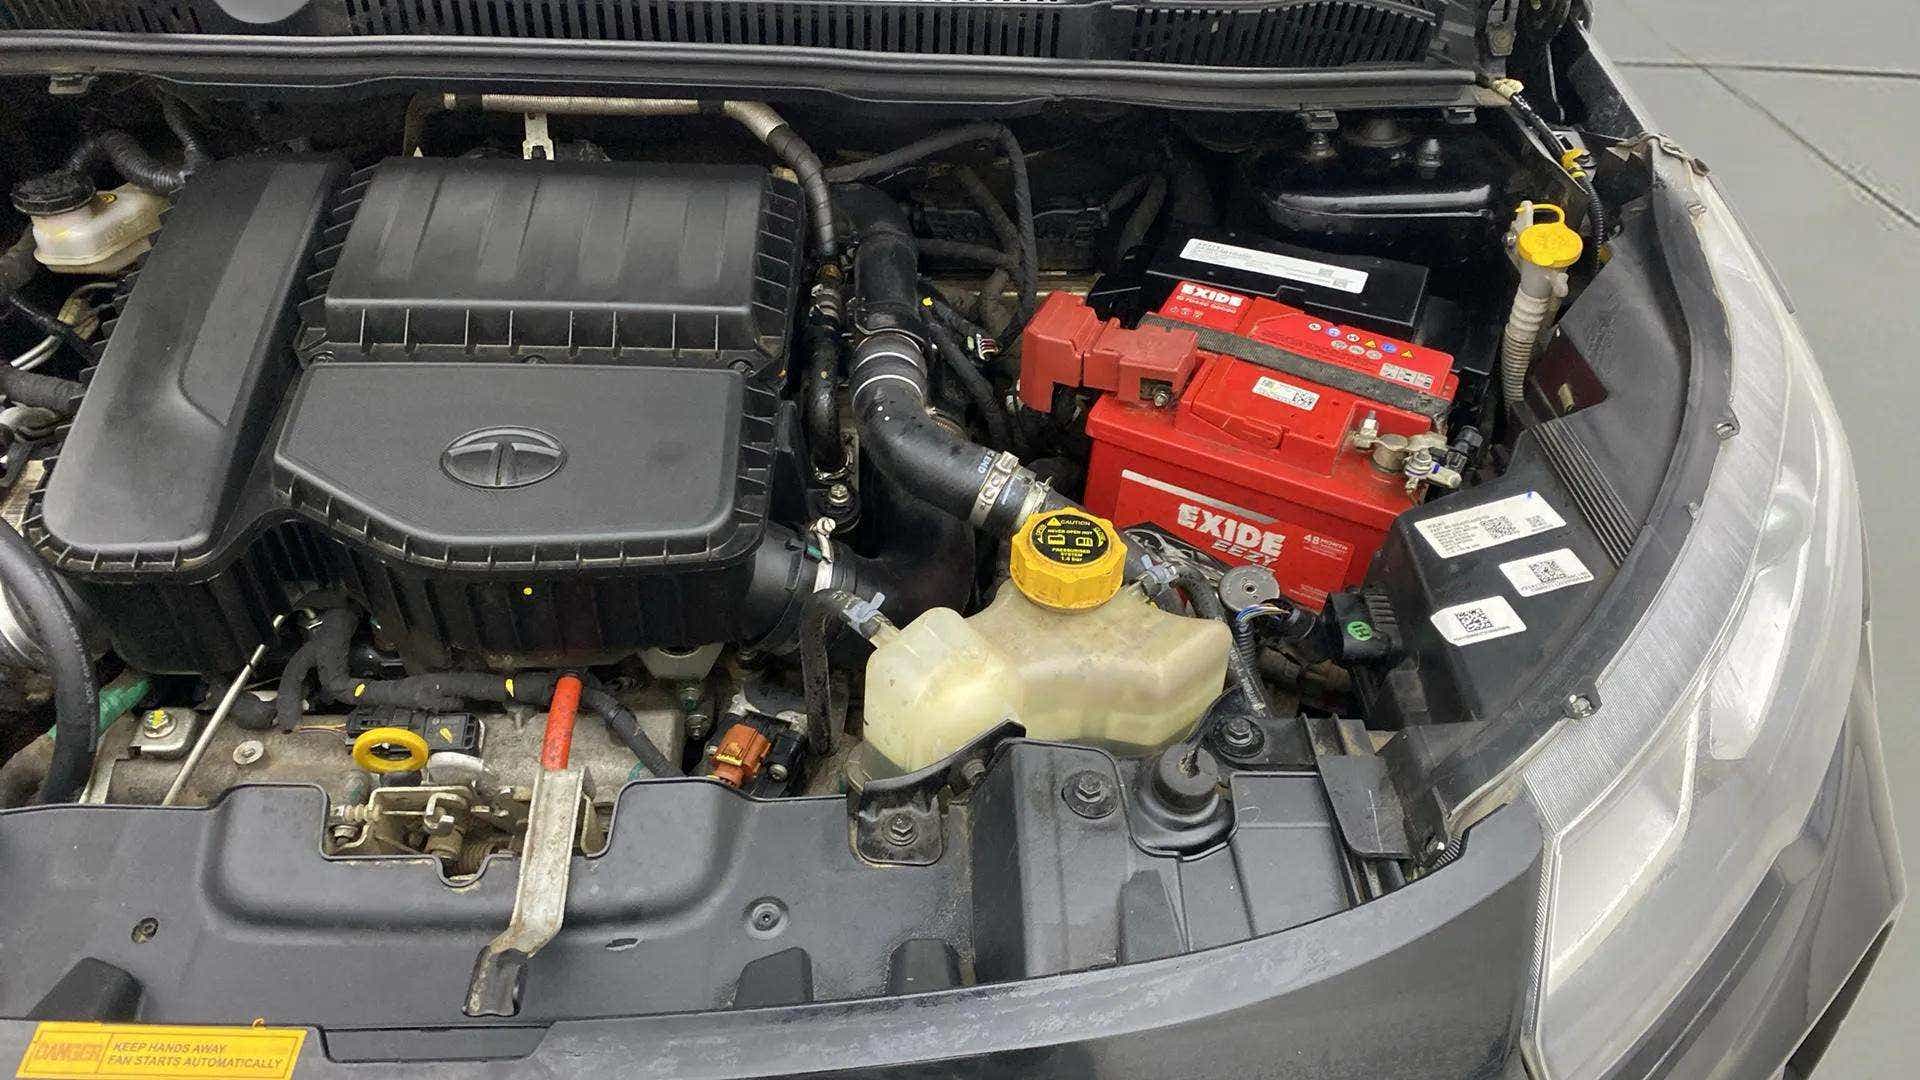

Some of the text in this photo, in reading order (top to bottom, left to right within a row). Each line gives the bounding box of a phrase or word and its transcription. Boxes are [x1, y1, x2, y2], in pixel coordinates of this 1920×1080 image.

[1181, 284, 1244, 307] EXIDE
[1177, 503, 1286, 557] EXIDE
[1303, 534, 1320, 544] 48
[1212, 539, 1278, 566] EEZY
[113, 1042, 228, 1054] KEEP HANDS AWAY
[107, 1055, 283, 1069] FAN STARTS AUTOMATICALLY
